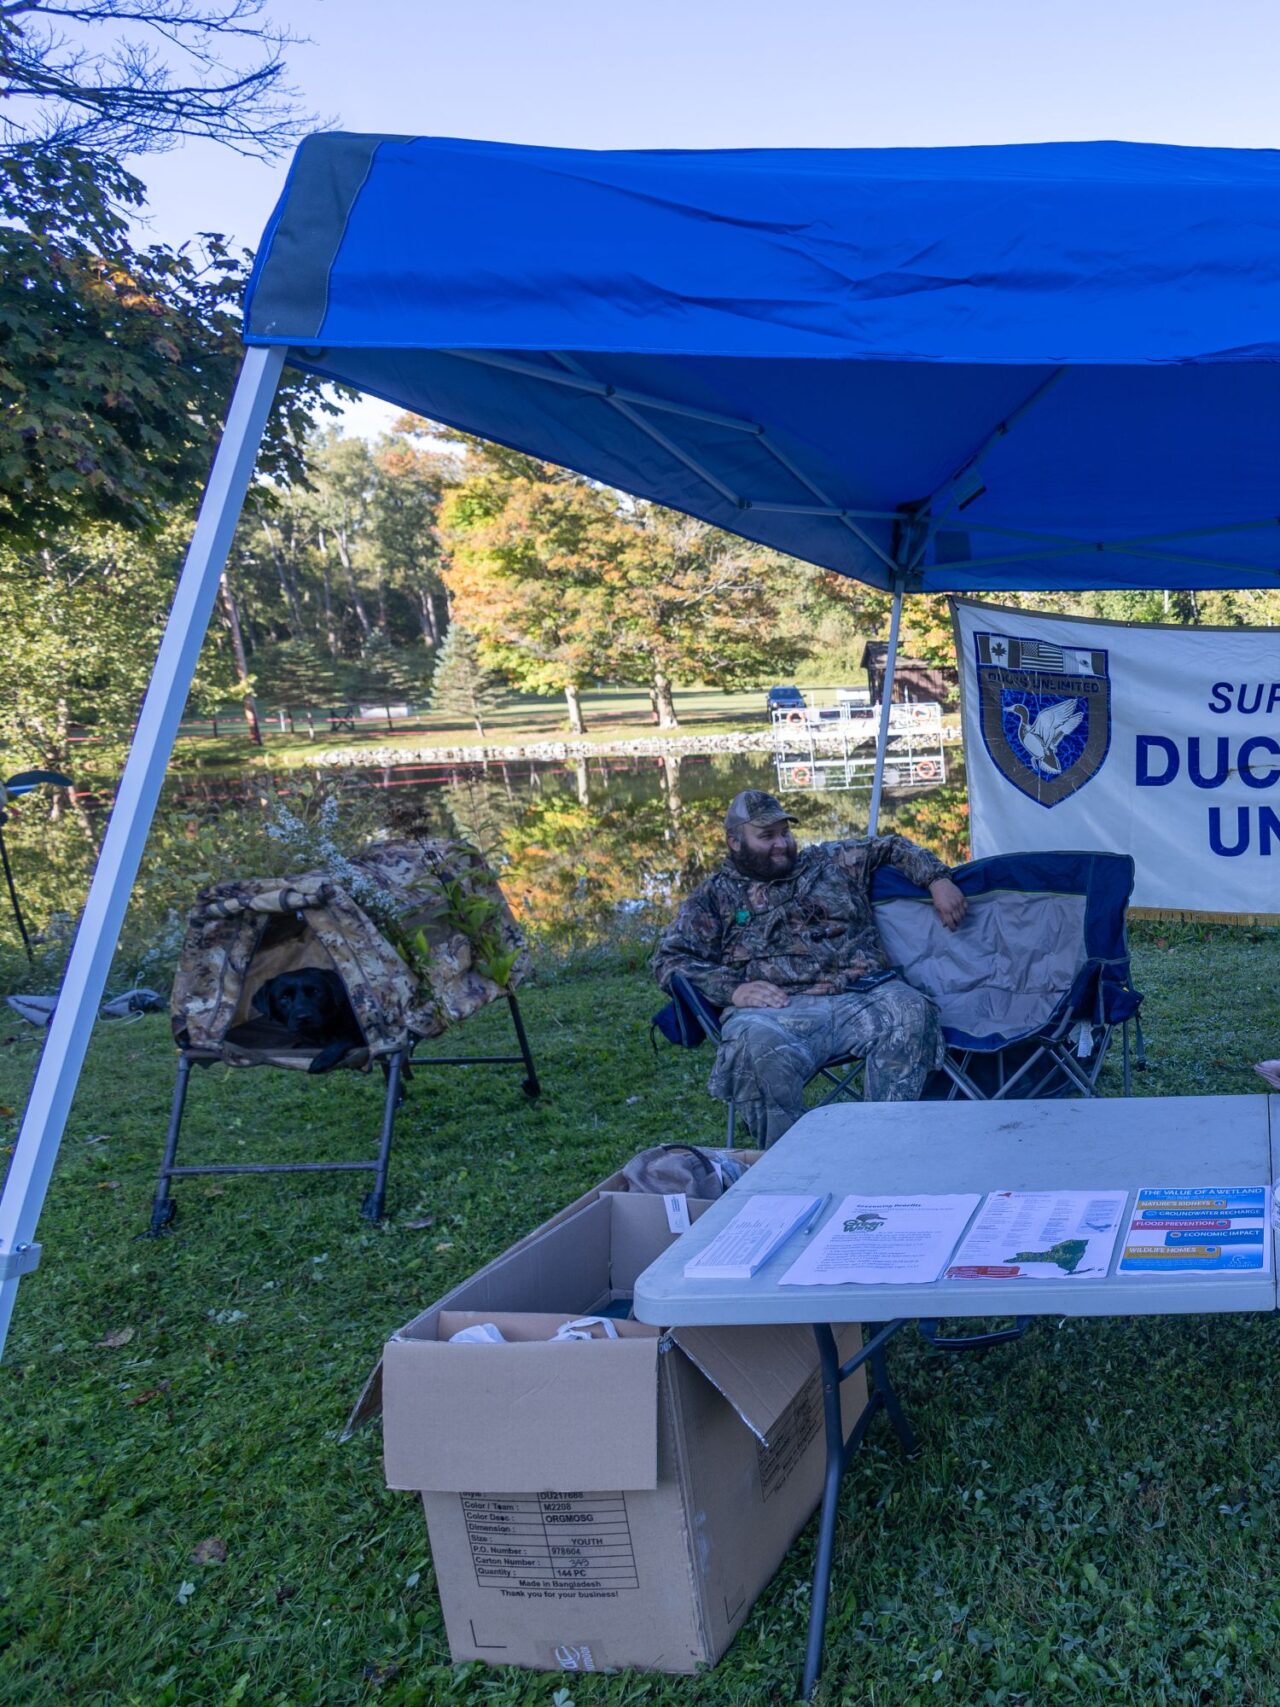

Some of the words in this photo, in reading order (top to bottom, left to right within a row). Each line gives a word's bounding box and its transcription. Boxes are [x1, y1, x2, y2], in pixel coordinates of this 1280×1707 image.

[1032, 680, 1100, 694] UNLIMITED
[1216, 1187, 1262, 1195] WETLAND
[464, 1501, 486, 1510] Color
[491, 1502, 515, 1511] Team
[543, 1502, 572, 1511] M2208
[466, 1511, 488, 1520] Color
[468, 1523, 511, 1533] Dimension
[571, 1538, 603, 1546] YOUTH
[490, 1546, 522, 1555] Number
[475, 1556, 502, 1565] Carton
[503, 1558, 536, 1566] Number
[477, 1567, 512, 1577] Quantity
[573, 1569, 587, 1577] PC
[552, 1580, 602, 1590] Bangladesh
[500, 1589, 526, 1597] Thank
[527, 1591, 543, 1599] you
[544, 1590, 556, 1598] for
[557, 1591, 577, 1600] your
[578, 1590, 619, 1599] business!
